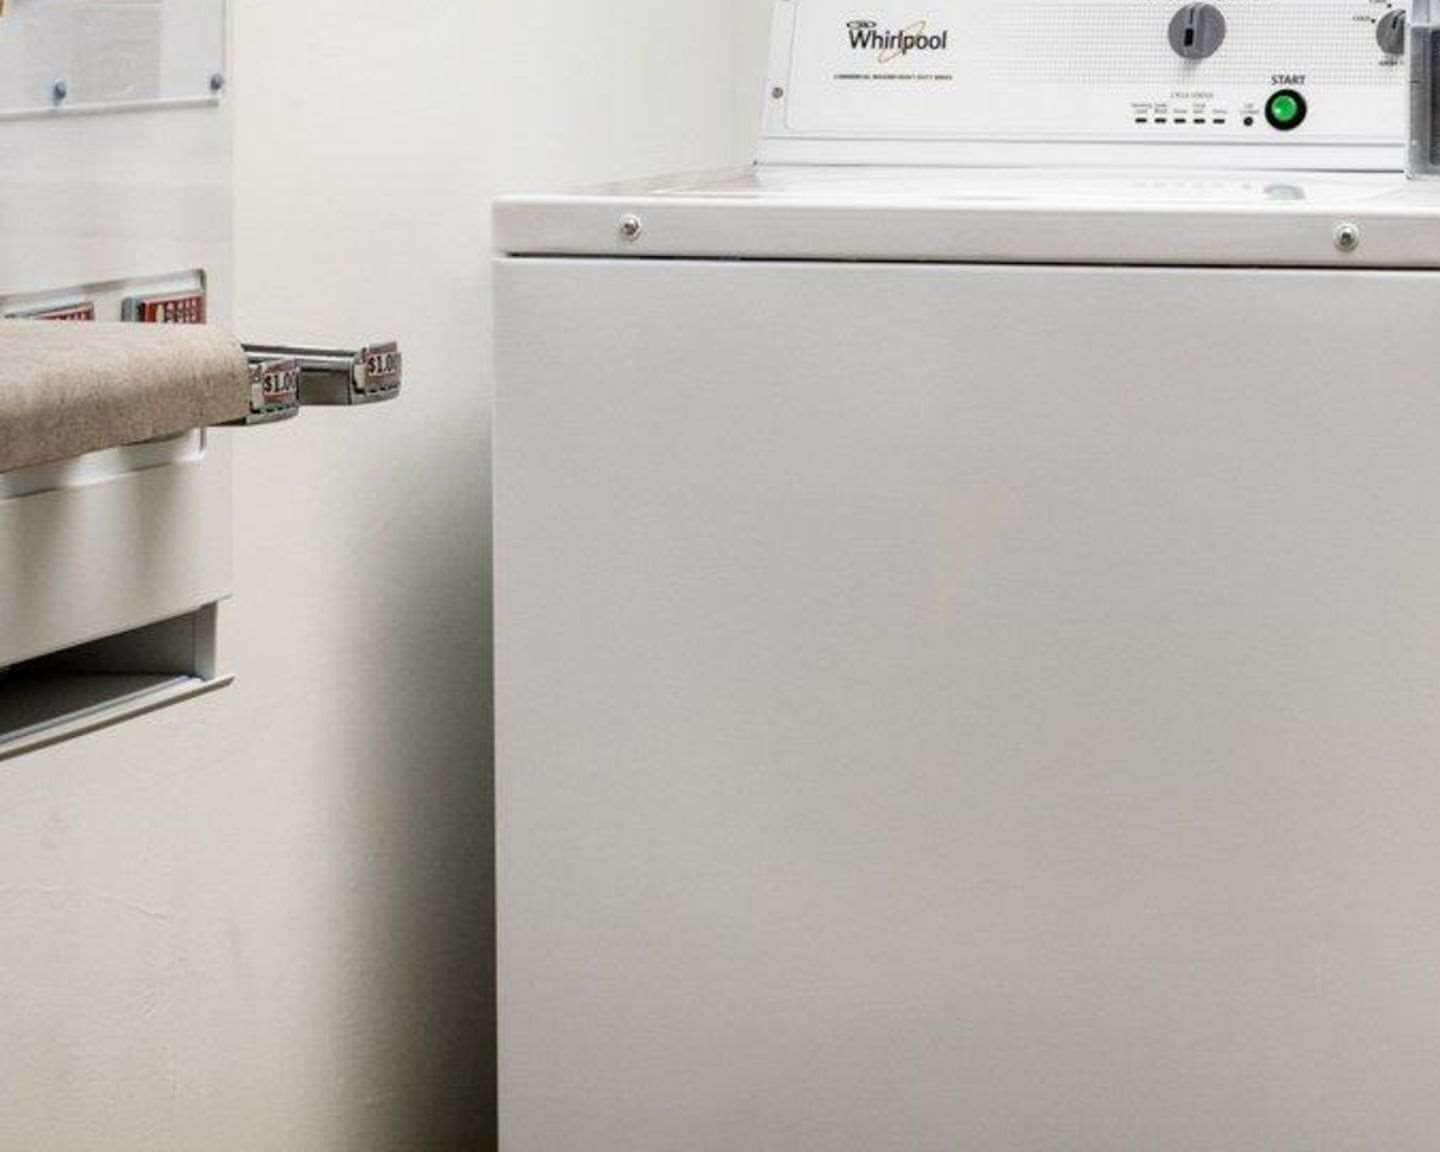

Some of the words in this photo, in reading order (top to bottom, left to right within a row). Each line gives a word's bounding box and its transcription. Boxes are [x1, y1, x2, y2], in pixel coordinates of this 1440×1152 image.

[848, 29, 948, 55] Whirlpool
[1271, 74, 1306, 86] START
[366, 352, 398, 376] $1.0
